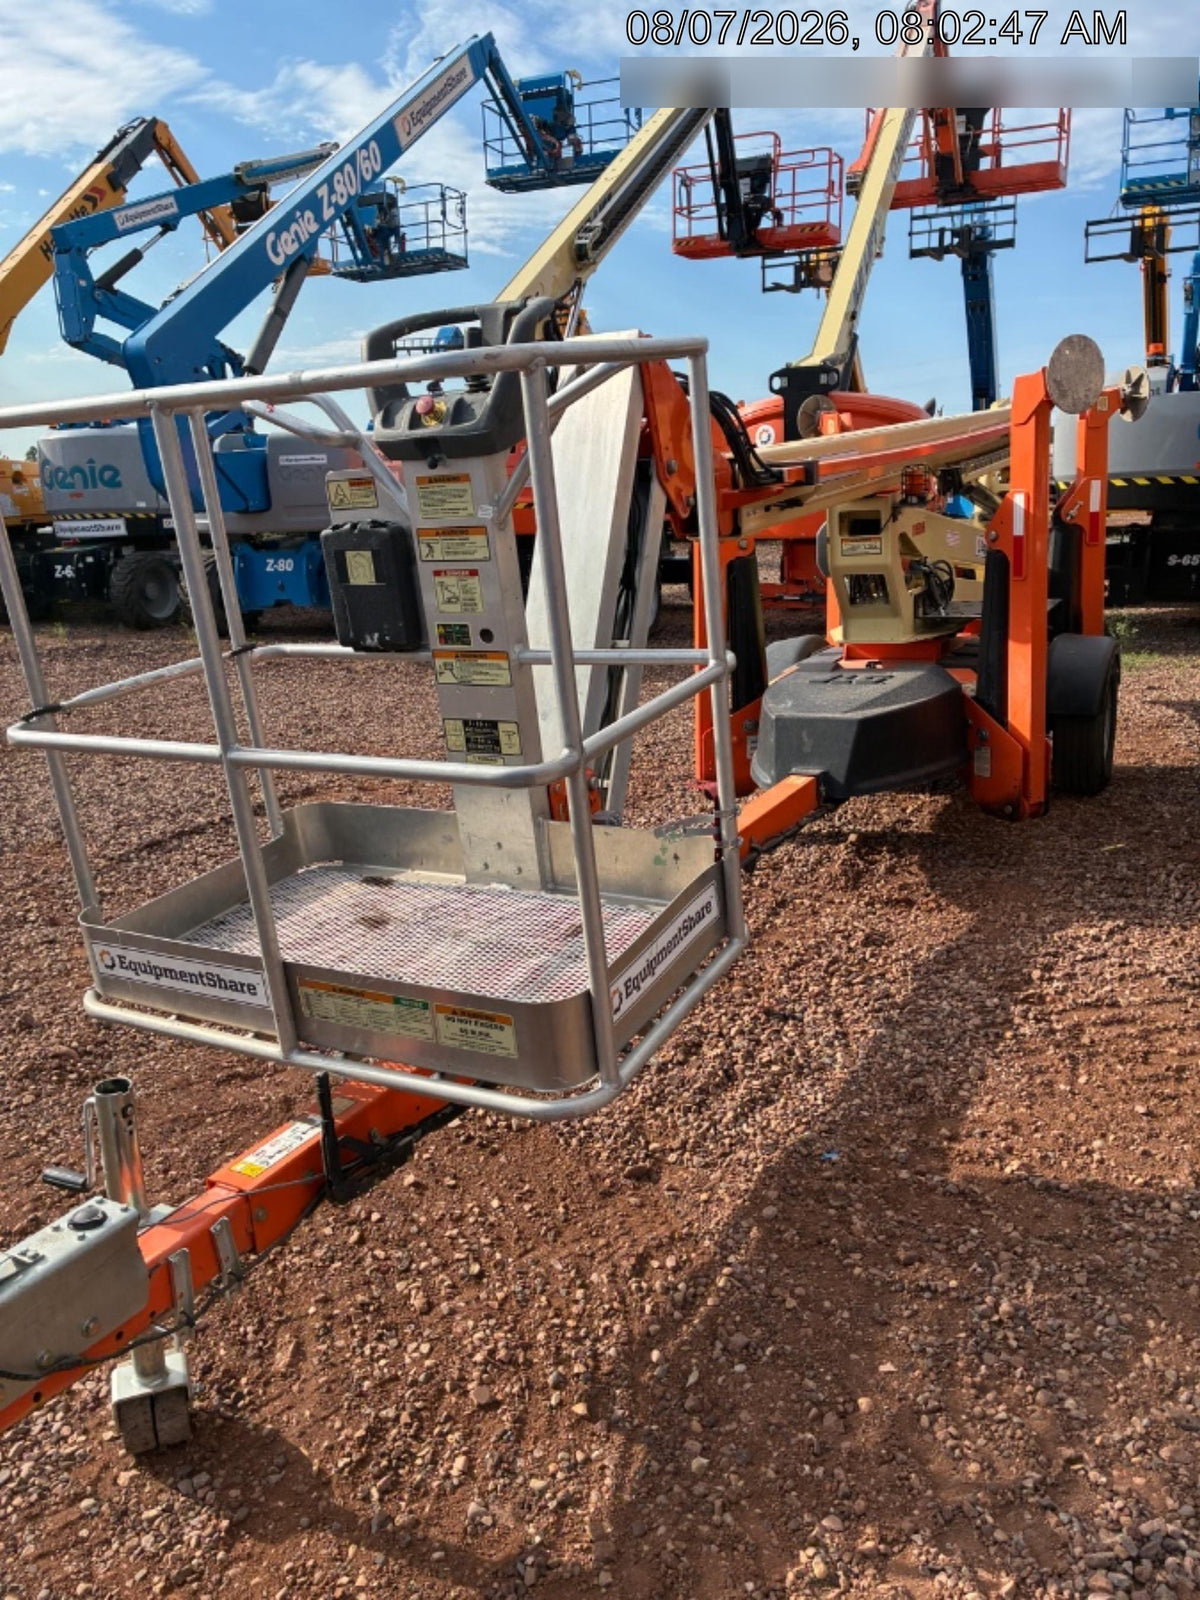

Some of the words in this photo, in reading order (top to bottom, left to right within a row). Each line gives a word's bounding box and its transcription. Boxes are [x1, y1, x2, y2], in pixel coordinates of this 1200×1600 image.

[409, 66, 467, 127] EquipmentShare
[266, 210, 320, 265] Genie
[316, 140, 381, 221] Z-80/60
[41, 457, 122, 490] Genie
[265, 558, 294, 572] Z-80
[117, 954, 258, 996] EquipmentShare
[623, 900, 712, 1000] EquipmentShare
